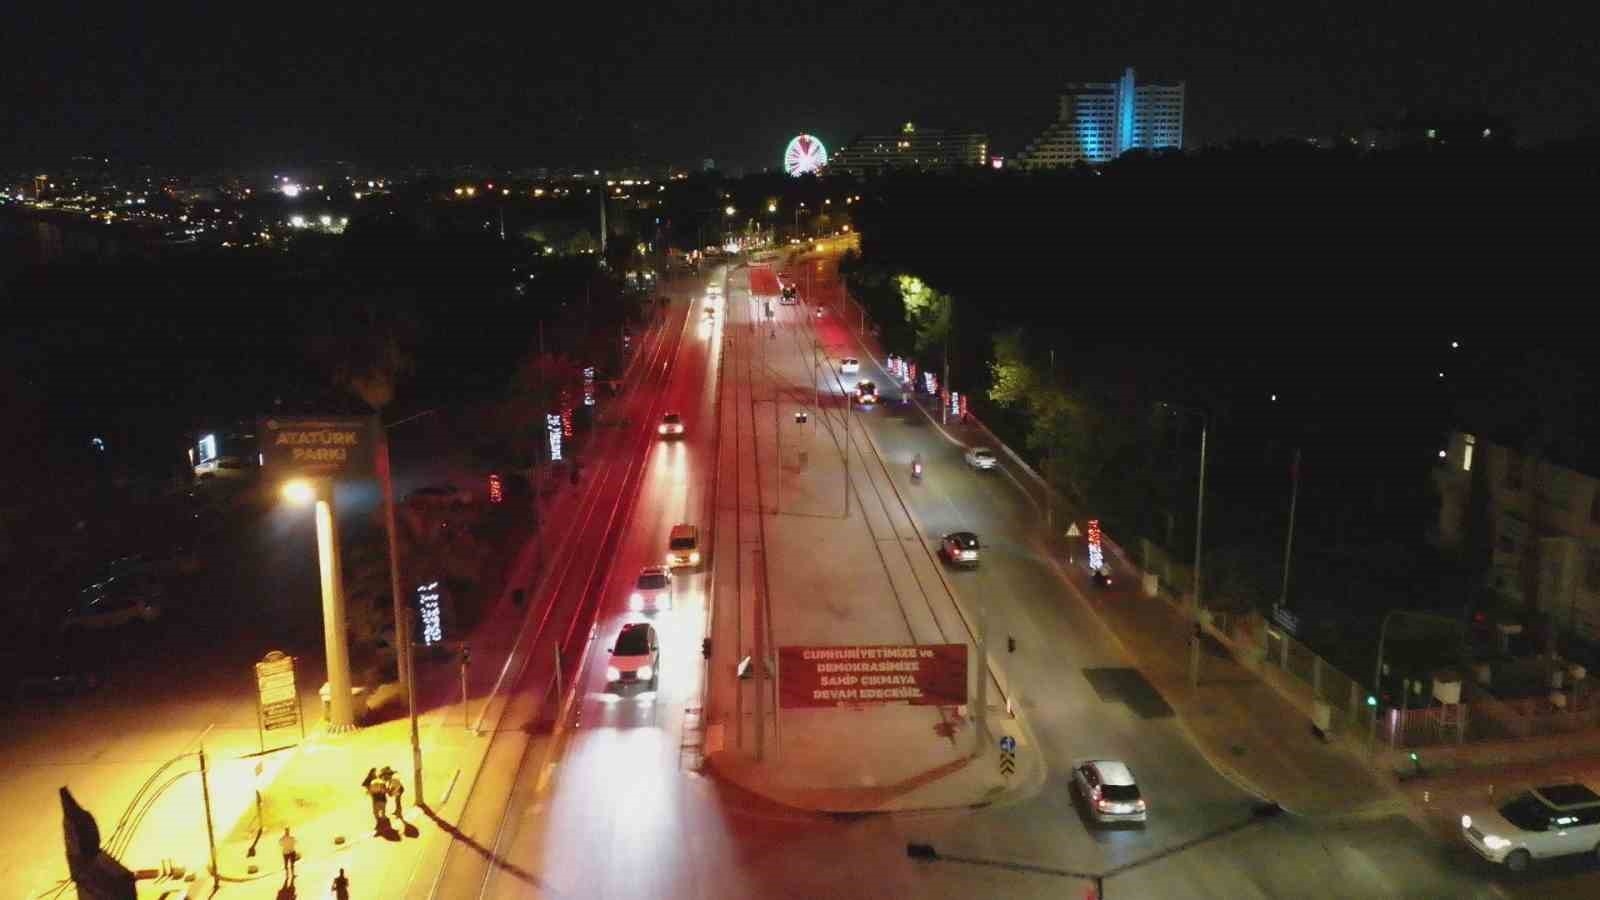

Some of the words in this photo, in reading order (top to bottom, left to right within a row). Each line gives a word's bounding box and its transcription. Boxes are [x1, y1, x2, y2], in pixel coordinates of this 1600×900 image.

[275, 431, 358, 446] ATATÜRK
[817, 660, 920, 672] DEMOKRASİMİZE
[821, 673, 858, 686] SAHİP
[813, 689, 857, 700] DEVAM
